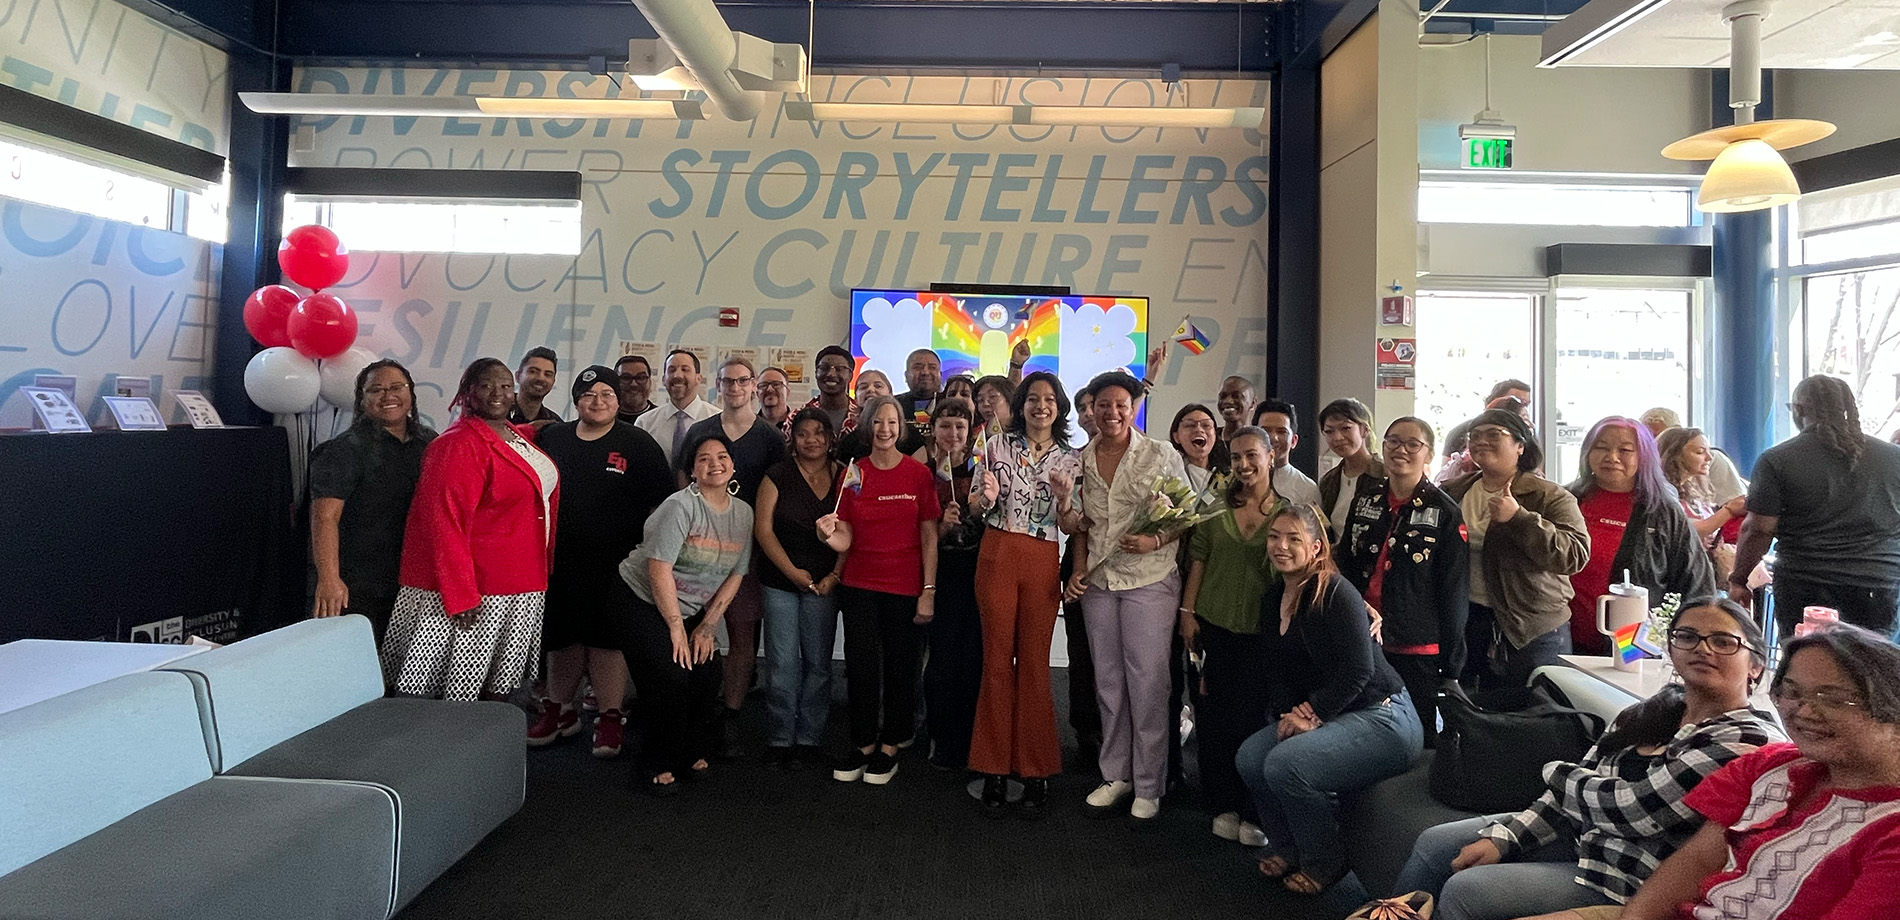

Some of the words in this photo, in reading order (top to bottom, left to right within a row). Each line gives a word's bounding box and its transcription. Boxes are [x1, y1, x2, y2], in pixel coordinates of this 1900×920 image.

[0, 0, 227, 113] NITY
[648, 148, 1268, 227] STORYTELLERS
[1470, 139, 1507, 168] EXIT
[753, 228, 1148, 300] CULTURE
[0, 278, 221, 363] OVE
[1558, 429, 1578, 437] EXIT
